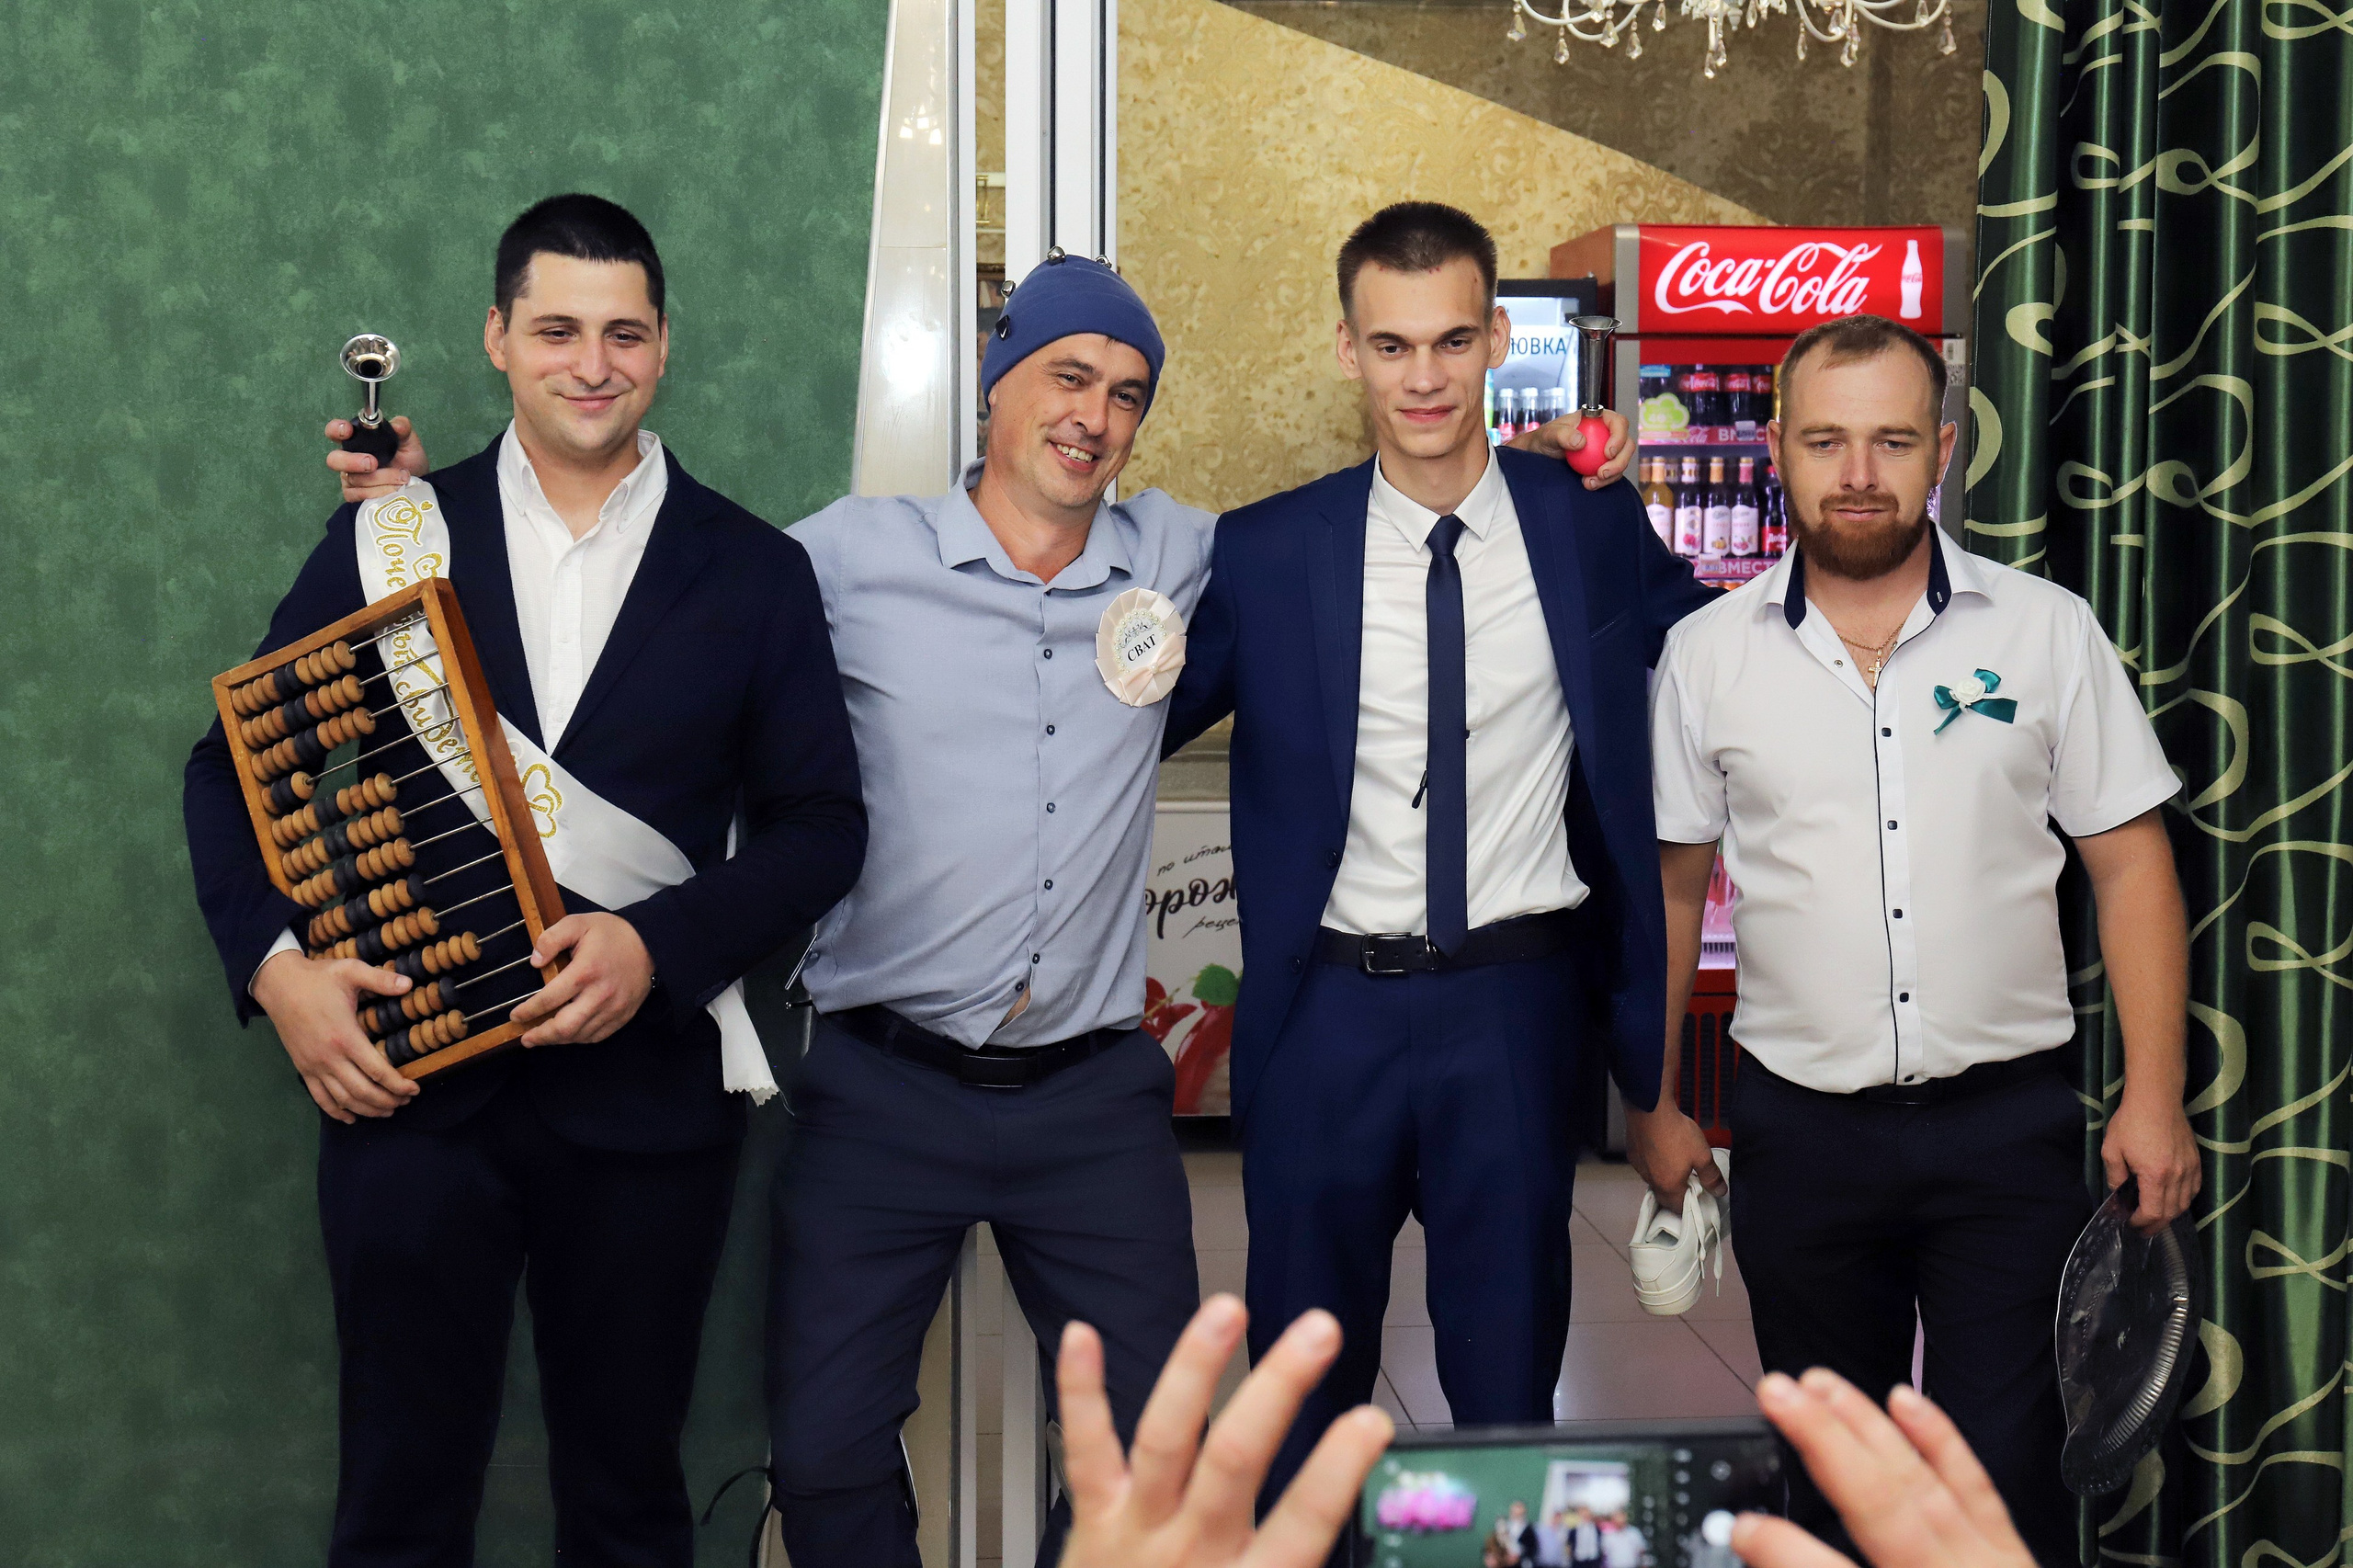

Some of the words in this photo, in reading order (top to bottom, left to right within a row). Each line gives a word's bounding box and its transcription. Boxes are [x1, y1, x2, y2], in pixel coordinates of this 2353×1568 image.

[1654, 242, 1883, 314] Coca-Cola
[1720, 561, 1780, 574] ВМЕСТ
[1127, 634, 1155, 662] СВАТ
[1181, 915, 1240, 938] реце
